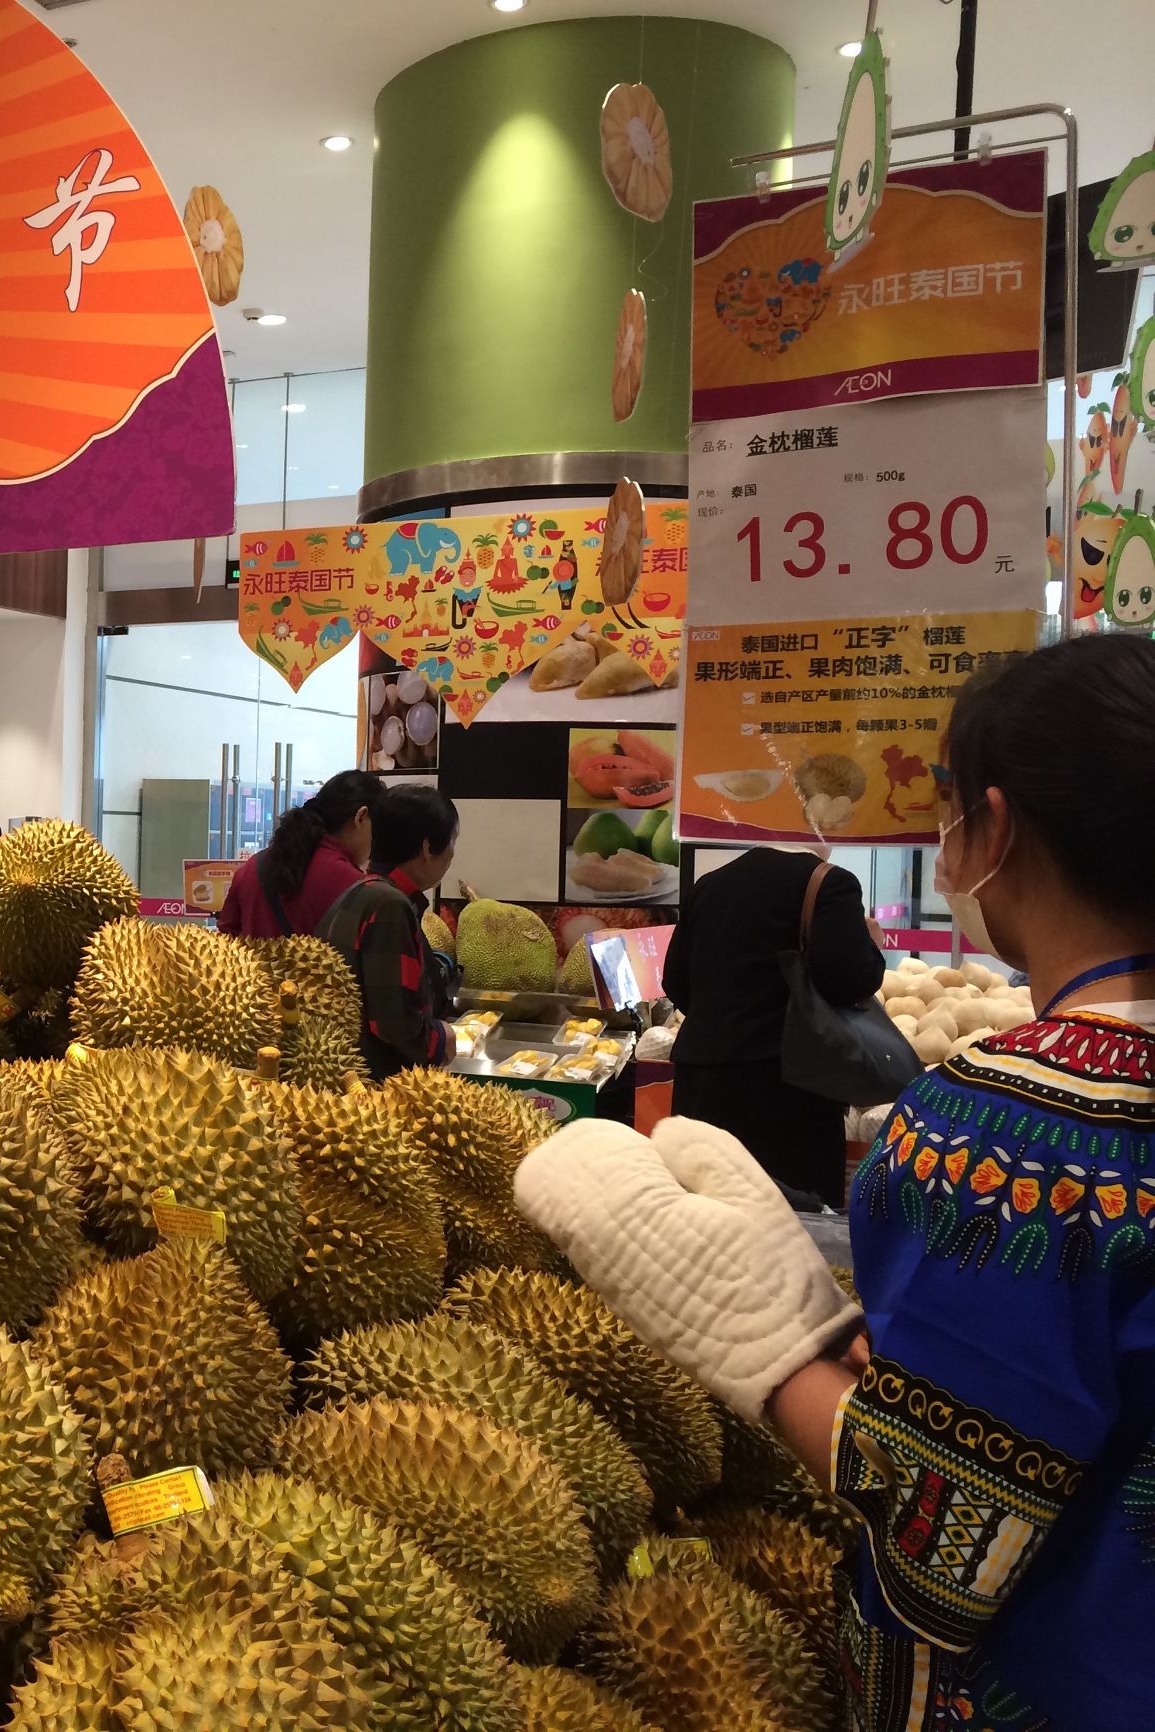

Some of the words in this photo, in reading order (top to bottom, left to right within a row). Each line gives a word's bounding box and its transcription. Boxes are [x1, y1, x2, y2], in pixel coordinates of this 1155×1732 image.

[838, 261, 1023, 315] 永旺泰国节
[747, 426, 839, 457] 金枕榴莲
[876, 470, 906, 482] 500g
[731, 484, 757, 498] 泰国
[994, 554, 1015, 574] 元
[244, 567, 355, 596] 永旺泰国节
[741, 632, 819, 654] 泰国进口
[923, 625, 966, 646] 榴莲
